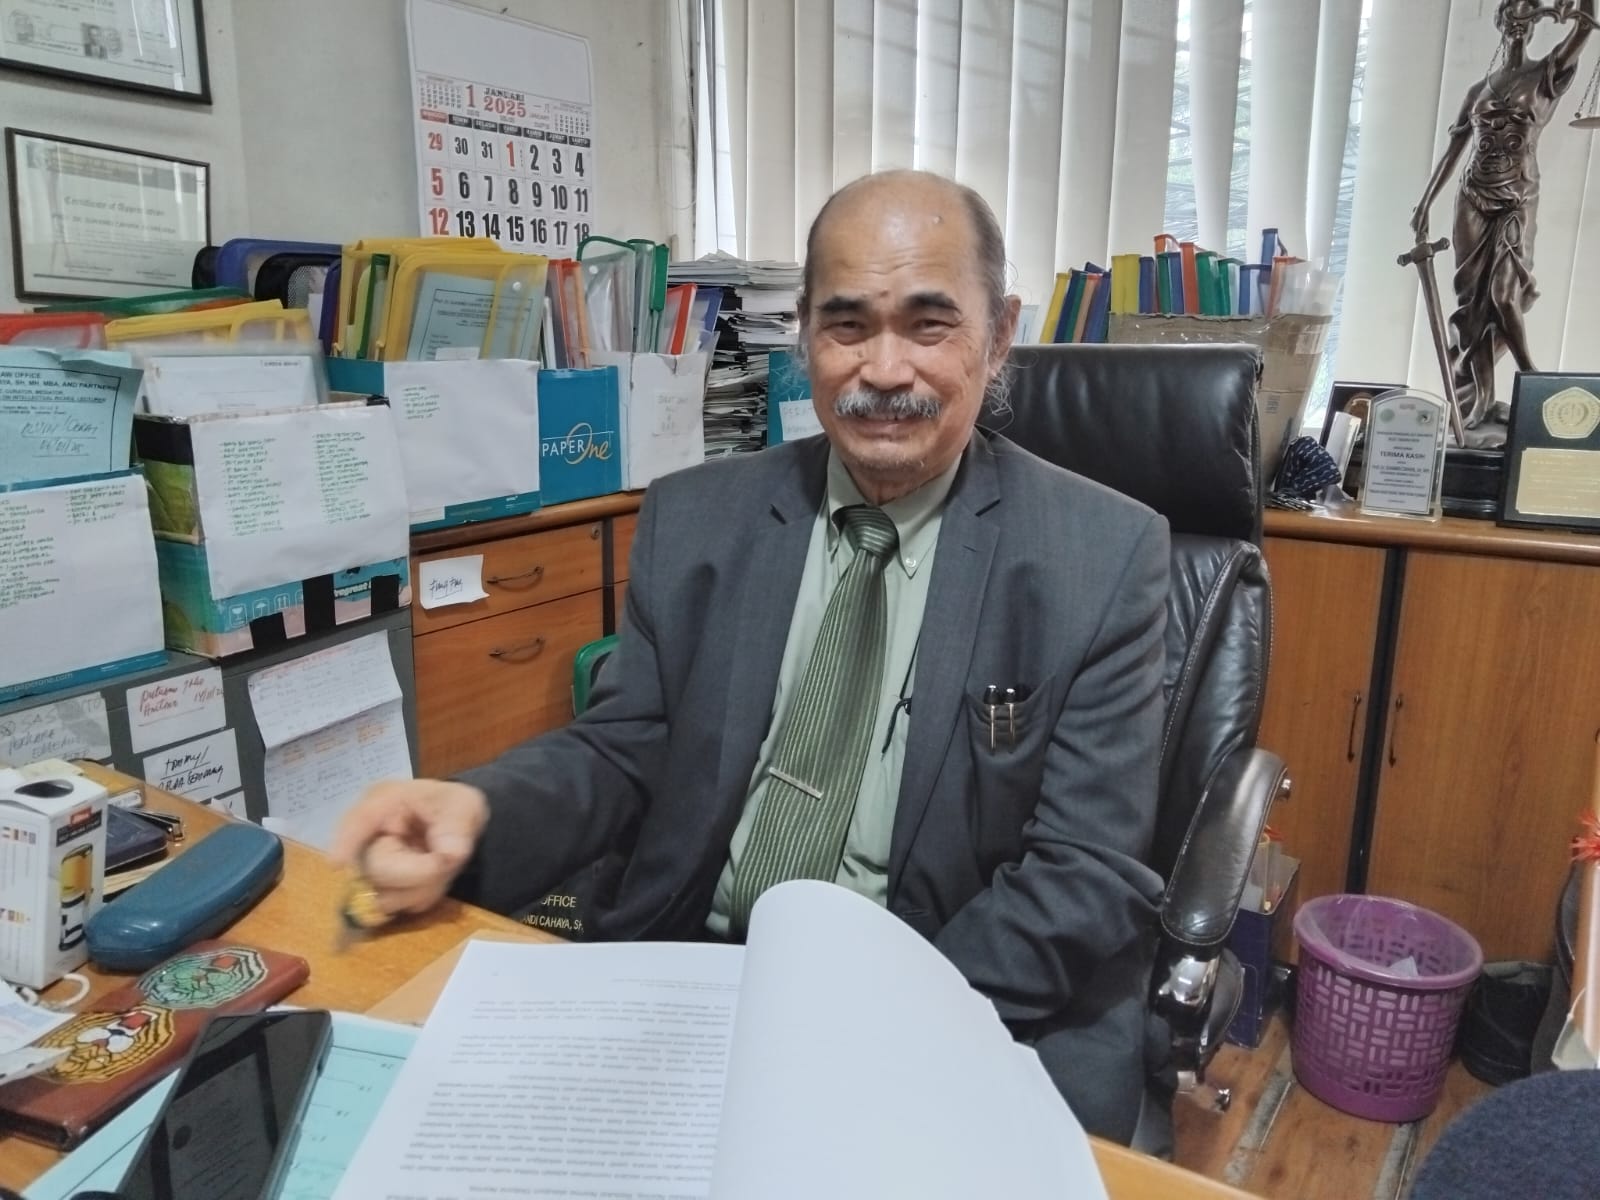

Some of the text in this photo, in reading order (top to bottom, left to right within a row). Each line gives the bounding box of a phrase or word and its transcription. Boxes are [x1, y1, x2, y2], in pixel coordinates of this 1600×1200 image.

[465, 84, 476, 108] 1
[484, 96, 527, 118] 2025
[484, 87, 525, 102] JANUARI
[428, 132, 584, 177] 29 30 31 1 2 3 4
[431, 168, 588, 213] 5 6 7 8 9 10 11
[428, 208, 590, 247] 12 13 14 15 16 17 18
[542, 439, 585, 457] PAPER
